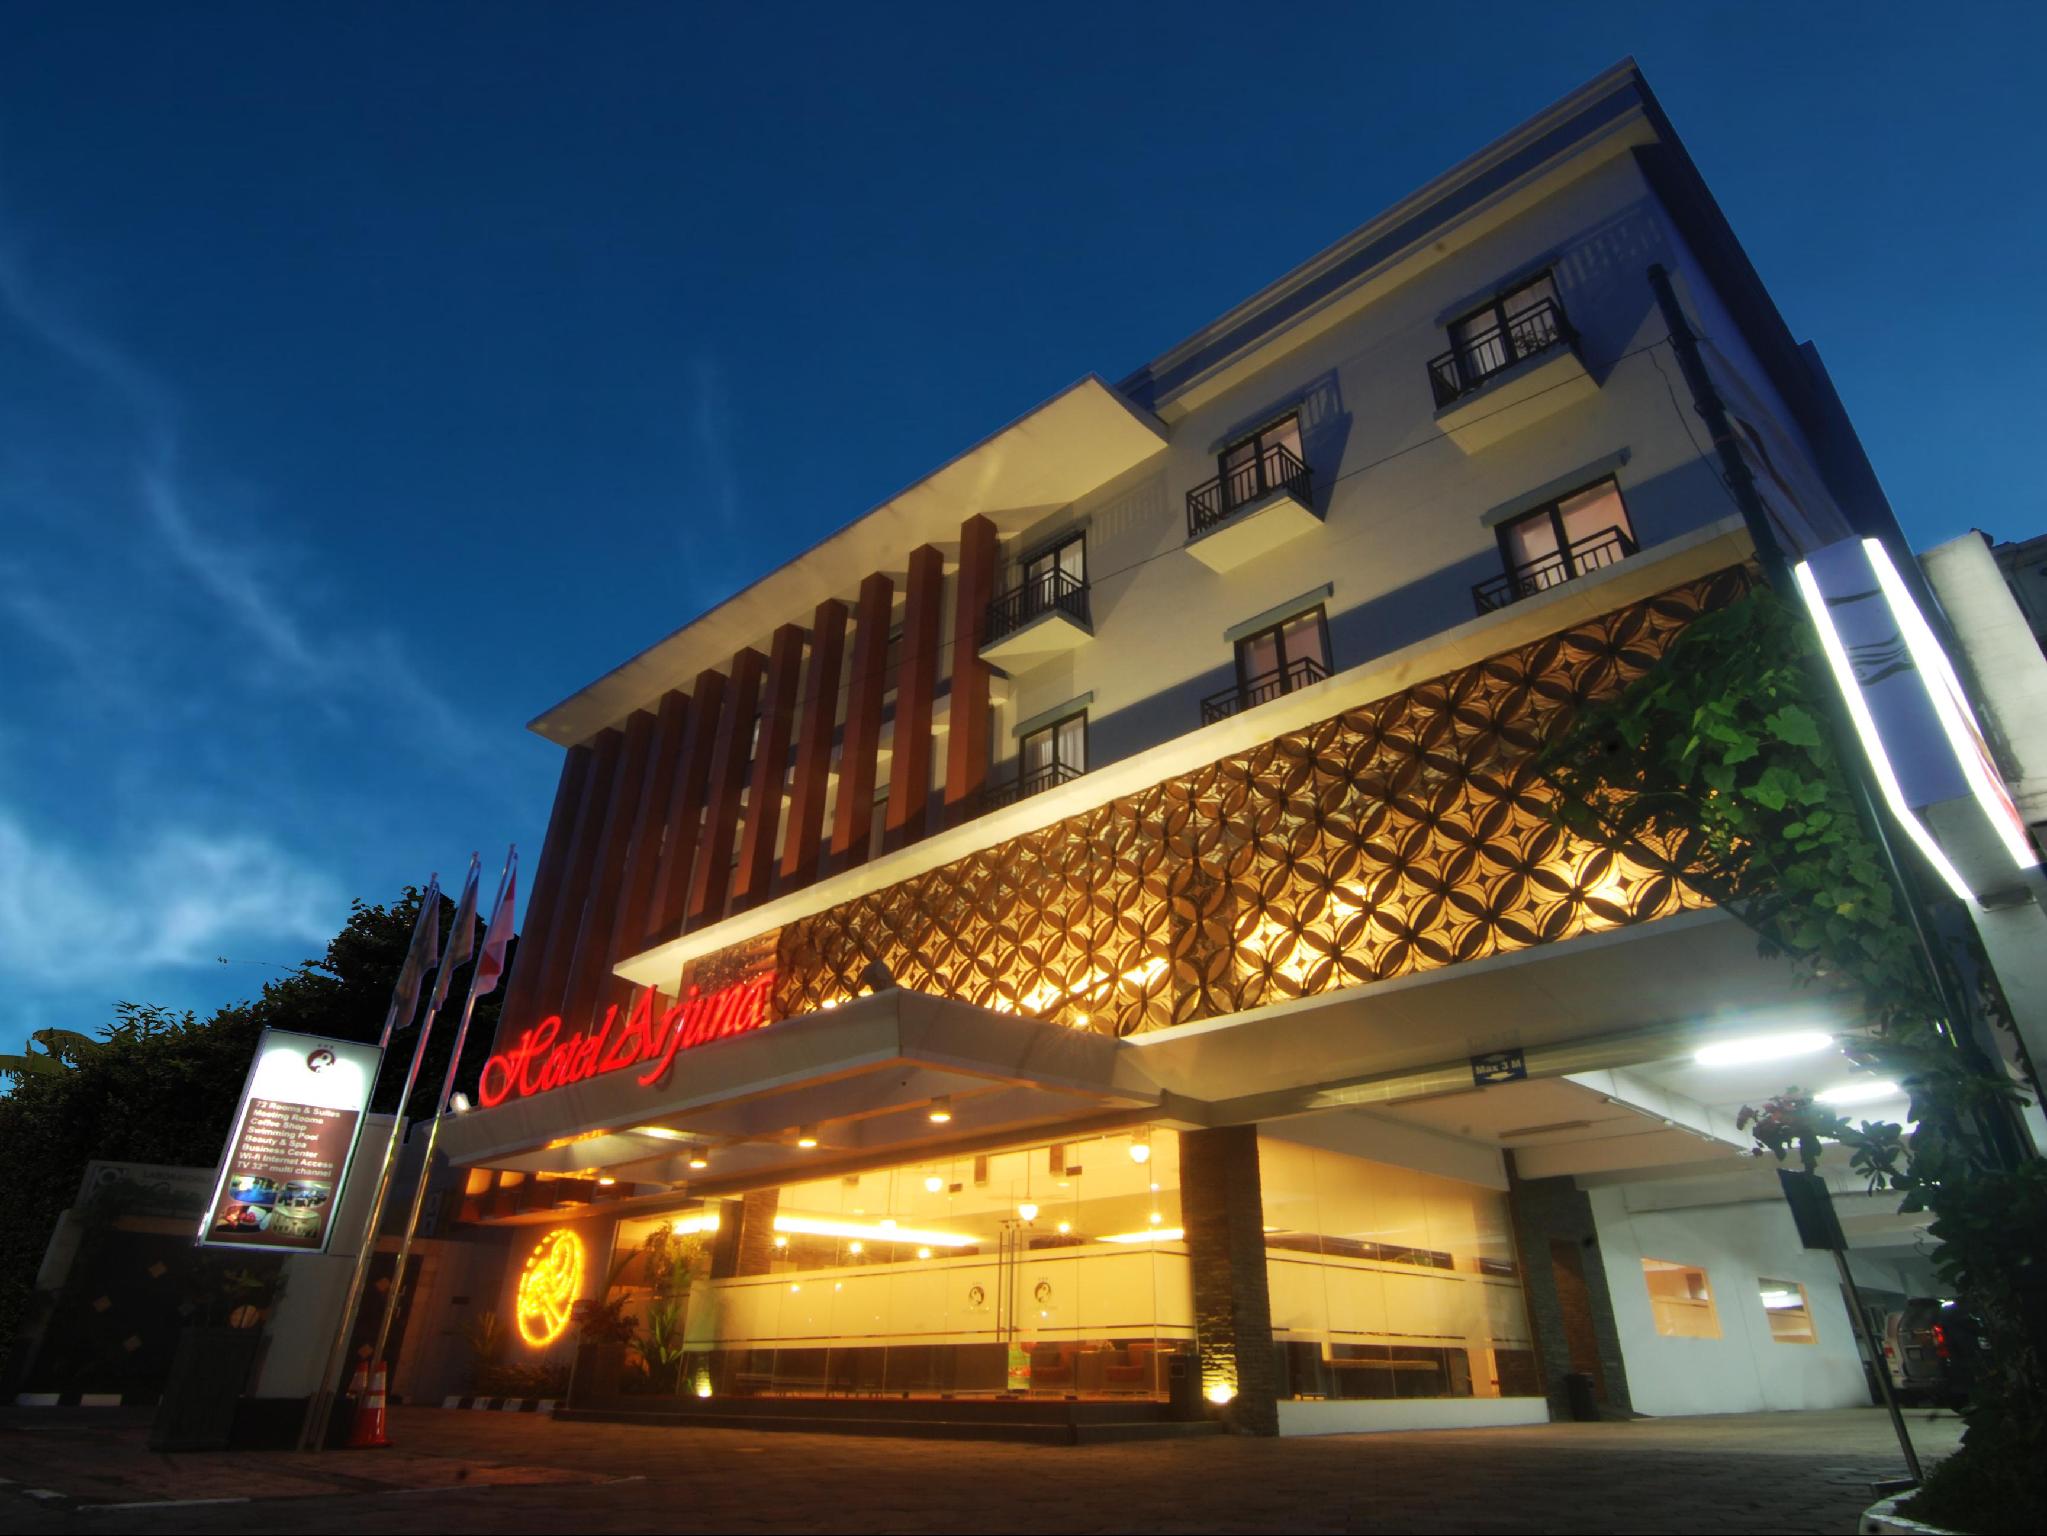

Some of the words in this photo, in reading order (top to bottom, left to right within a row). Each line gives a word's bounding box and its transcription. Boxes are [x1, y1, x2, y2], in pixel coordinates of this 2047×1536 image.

[478, 1003, 619, 1108] Hotel
[598, 970, 778, 1087] Arjuna
[1476, 1063, 1499, 1075] Max
[1501, 1061, 1509, 1071] 3
[1511, 1058, 1522, 1069] M
[256, 1100, 269, 1109] 72
[268, 1102, 301, 1113] Rooms
[303, 1106, 311, 1114] &
[312, 1107, 341, 1118] Suites
[253, 1109, 289, 1120] Meeting
[291, 1114, 324, 1125] Rooms
[250, 1118, 281, 1127] Coffee
[282, 1121, 308, 1132] Shop
[247, 1126, 296, 1139] Swimming
[297, 1131, 320, 1140] Pool
[245, 1134, 277, 1146] Beauty
[288, 1140, 307, 1149] Spa
[242, 1143, 285, 1154] Business
[287, 1149, 319, 1158] Center
[262, 1155, 298, 1165] Internet
[300, 1159, 334, 1168] Access
[269, 1165, 293, 1173] multi
[294, 1167, 332, 1177] channel
